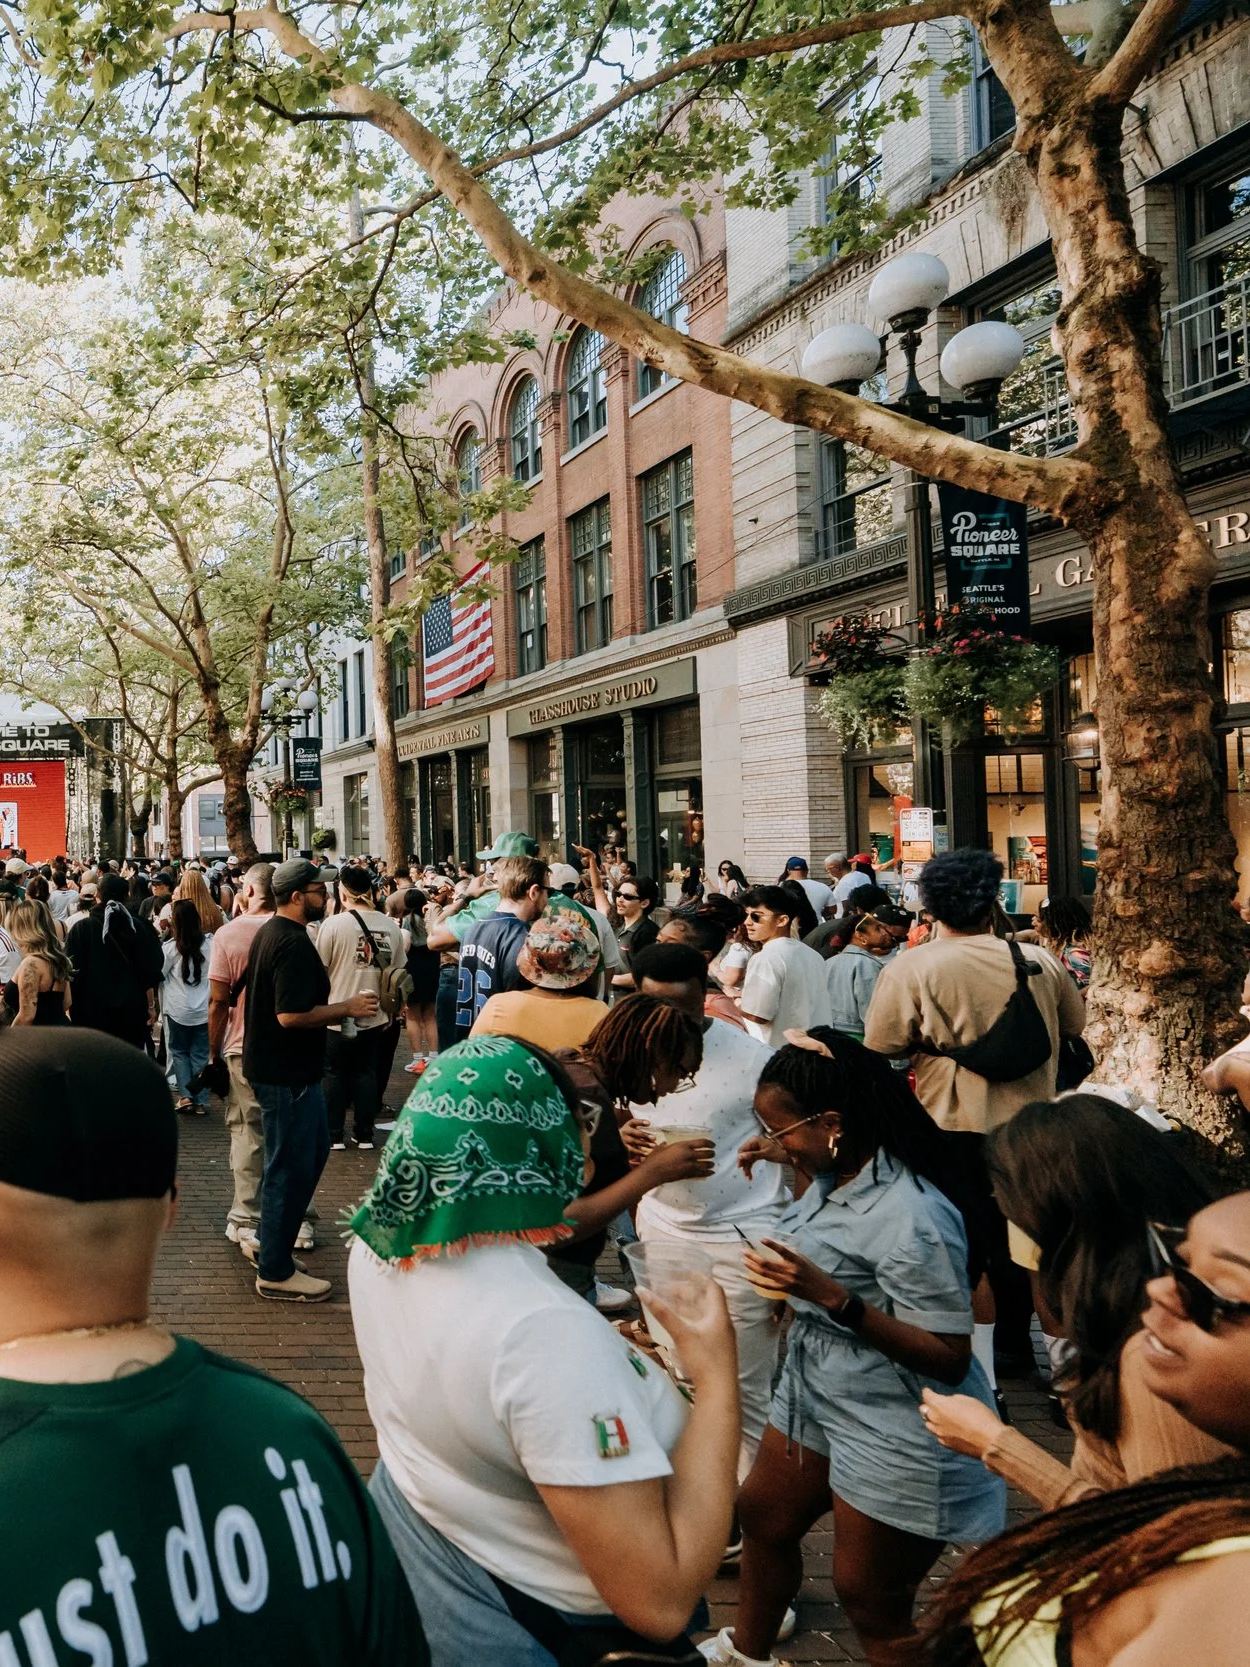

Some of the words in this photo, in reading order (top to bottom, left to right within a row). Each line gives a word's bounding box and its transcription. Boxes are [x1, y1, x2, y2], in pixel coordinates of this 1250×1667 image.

[950, 511, 1019, 543] Pioneer
[950, 543, 1020, 558] SQUARE
[961, 584, 1005, 593] SEATTLE'S
[961, 596, 1005, 604] RIGINAL
[529, 691, 600, 725] GLASSHOUSE
[604, 676, 657, 706] STUDIO
[22, 725, 50, 737] TO
[398, 736, 437, 757] CCIDENTAL
[438, 731, 456, 747] FINE
[457, 724, 481, 742] ARTS
[165, 1463, 269, 1633] do
[264, 1447, 351, 1590] it.
